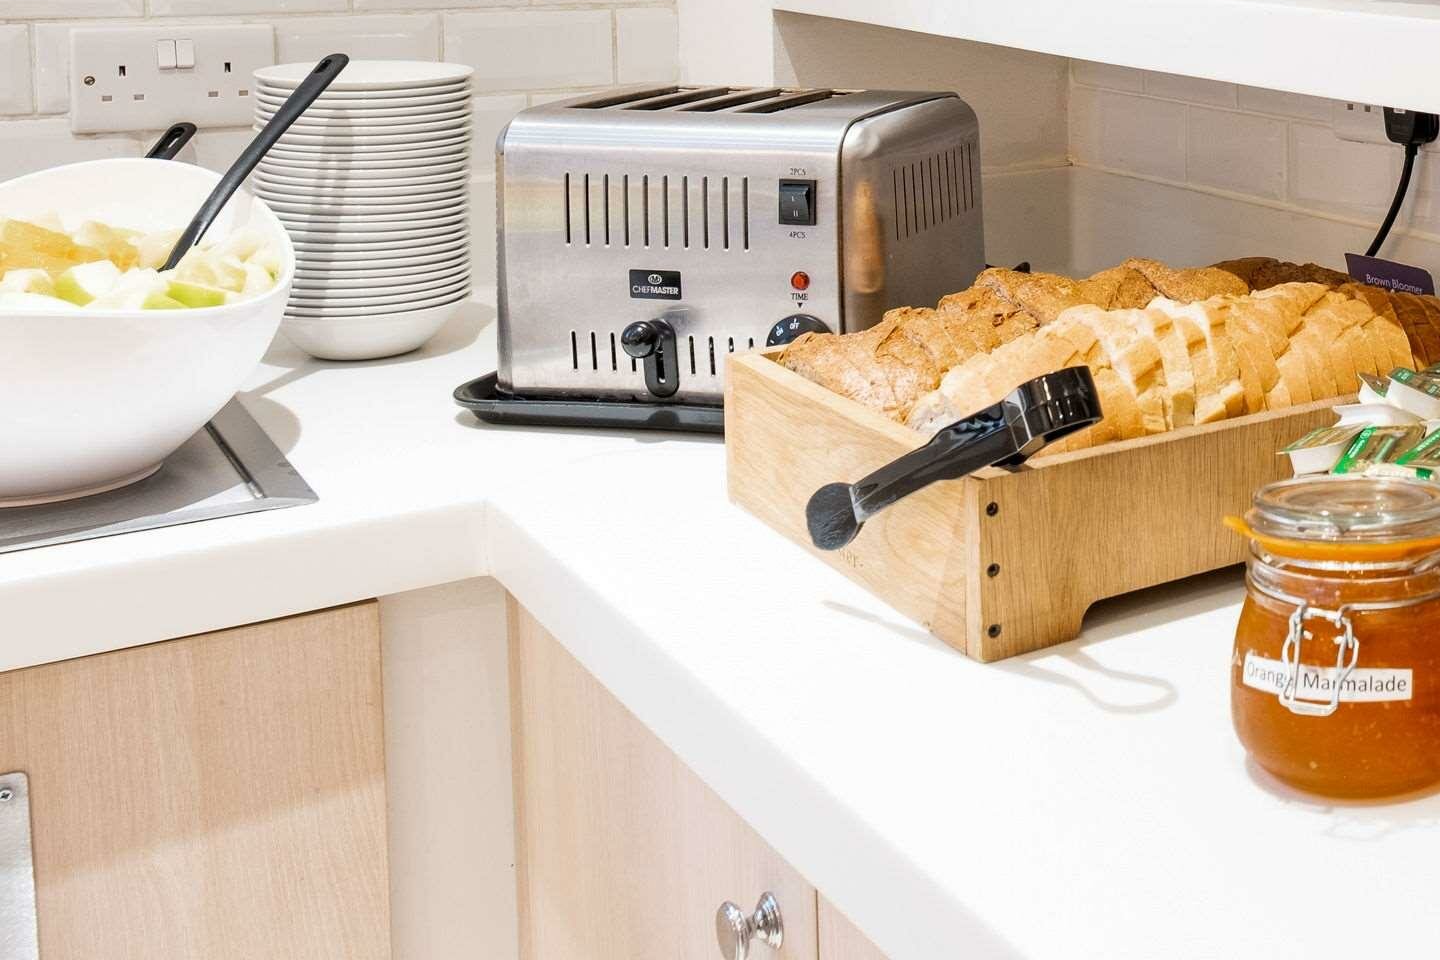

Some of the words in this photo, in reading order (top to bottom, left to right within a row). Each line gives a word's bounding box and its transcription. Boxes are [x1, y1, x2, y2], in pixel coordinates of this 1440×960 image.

[1366, 274, 1391, 288] Brown
[1392, 279, 1423, 294] Bloomer
[1303, 672, 1407, 693] Marmalade
